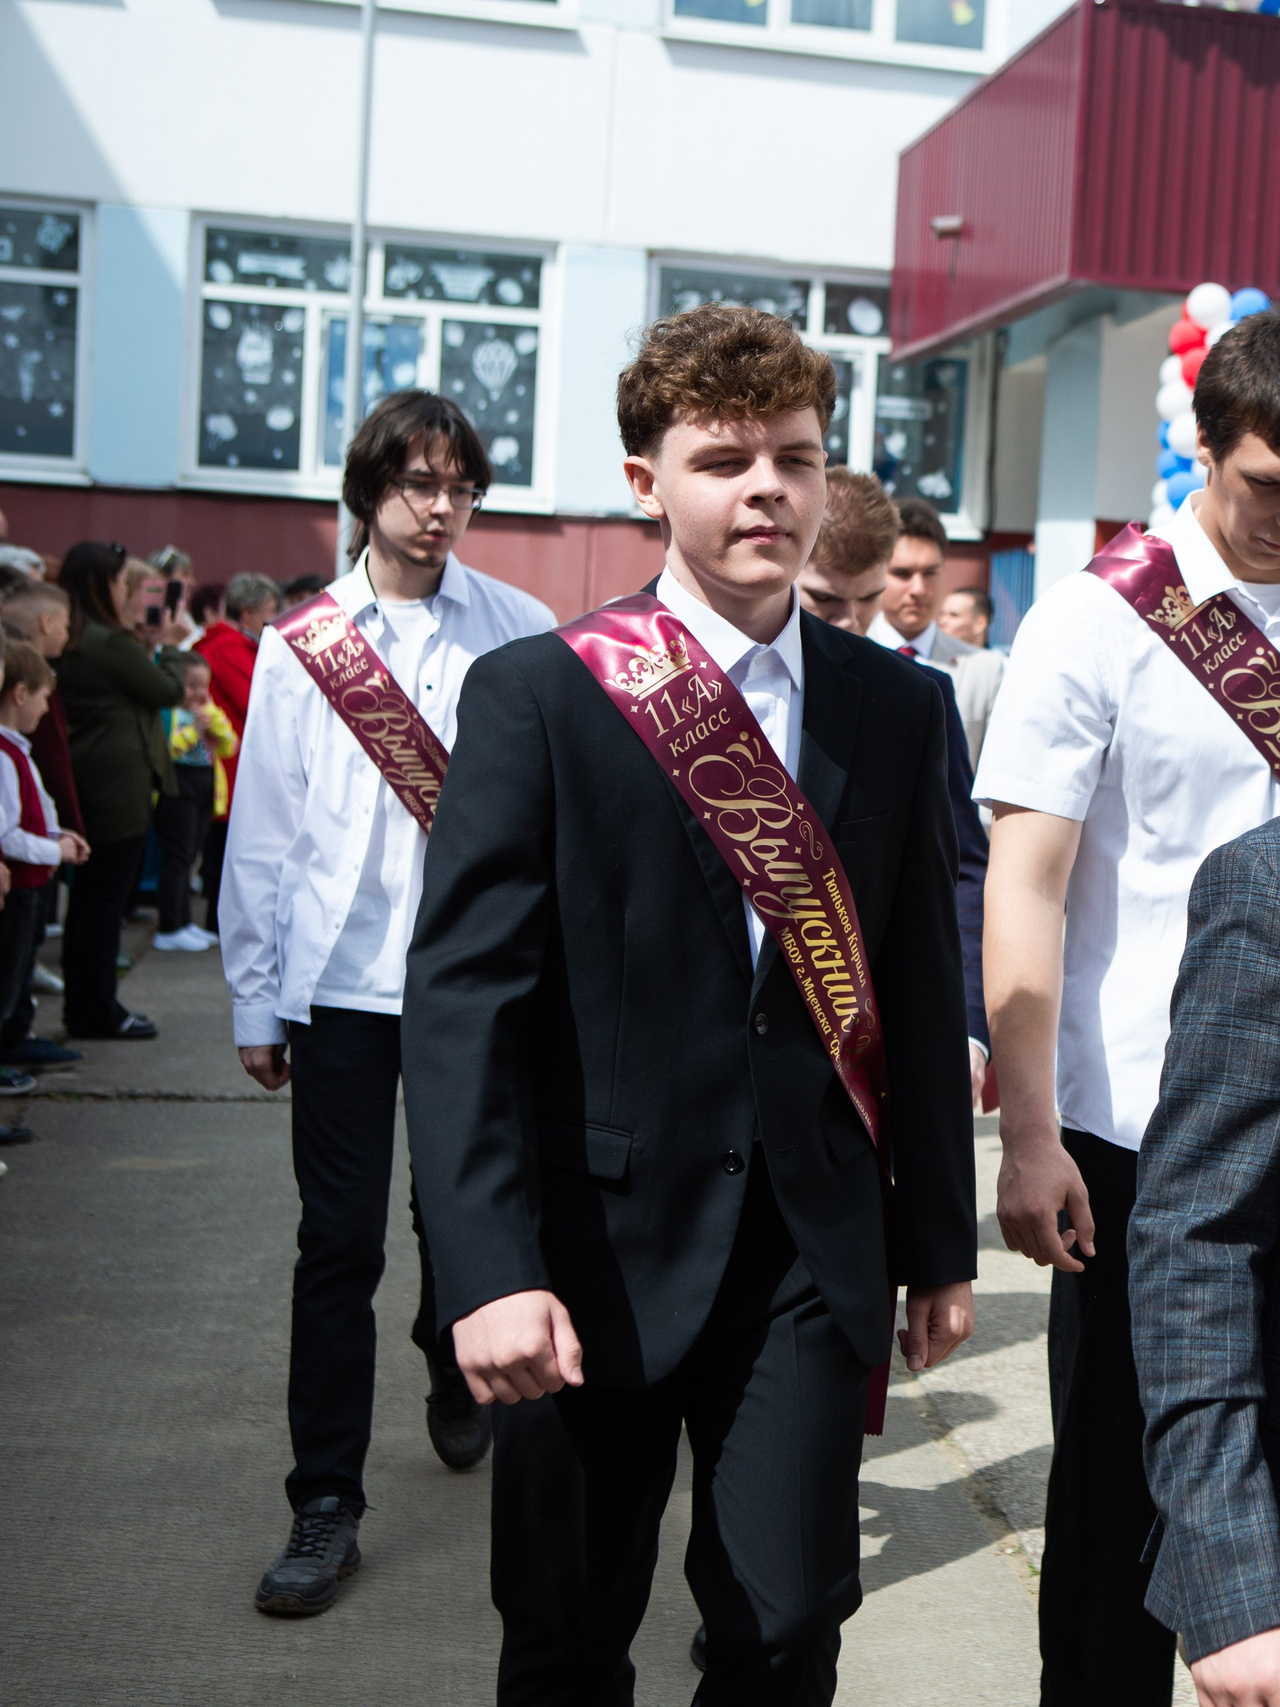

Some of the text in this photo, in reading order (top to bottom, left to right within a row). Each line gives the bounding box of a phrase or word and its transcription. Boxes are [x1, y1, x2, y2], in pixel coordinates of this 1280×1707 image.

[1180, 606, 1237, 661] 11«А»
[1202, 632, 1248, 675] класс
[329, 658, 369, 690] класс
[645, 673, 722, 738] 11«А»
[668, 707, 731, 757] класс
[688, 731, 860, 1032] Выпускник
[822, 868, 867, 988] Тюньков Кирилл
[779, 926, 804, 964] МБОУ
[796, 967, 806, 978] г.
[801, 976, 833, 1035] Мценска
